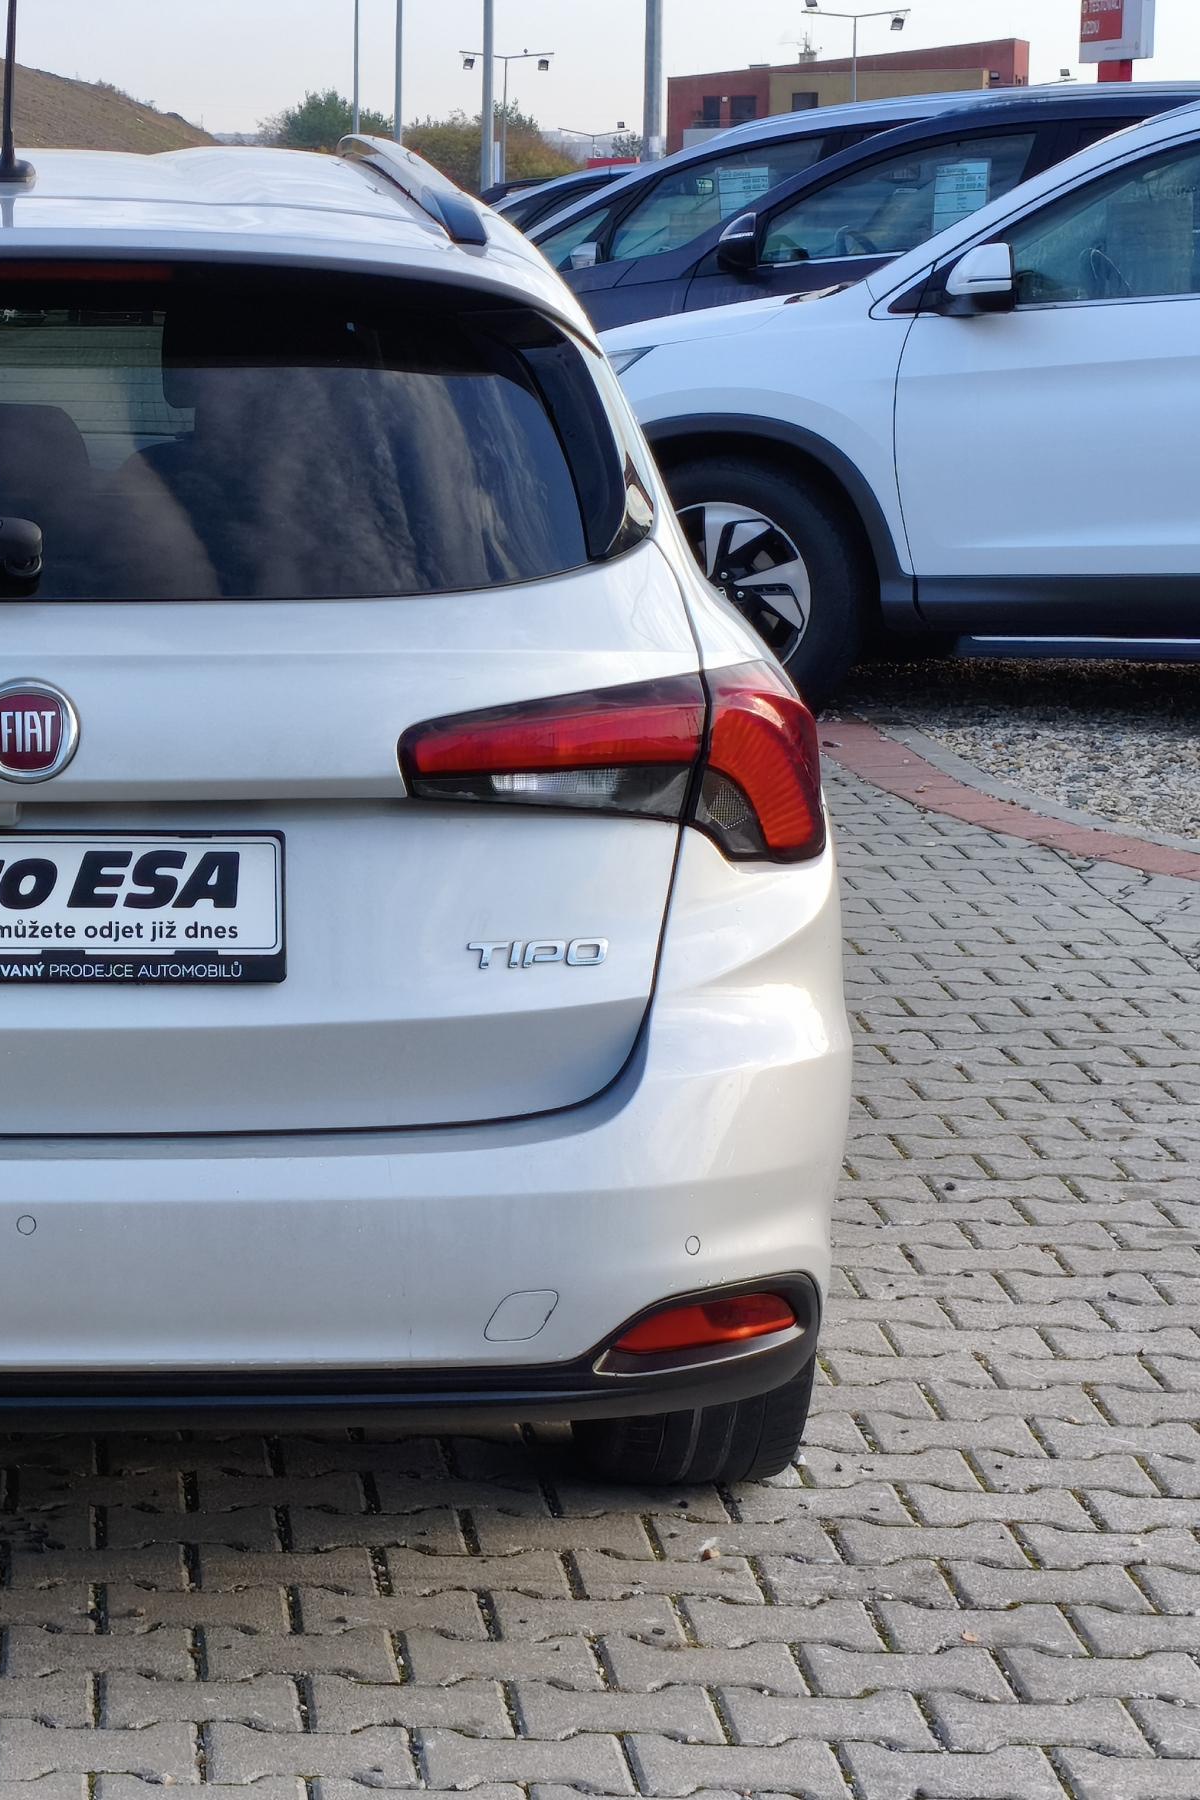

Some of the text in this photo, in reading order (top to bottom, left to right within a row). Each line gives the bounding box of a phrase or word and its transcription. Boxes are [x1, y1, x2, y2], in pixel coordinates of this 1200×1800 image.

[0, 711, 56, 752] FIAT
[67, 850, 240, 909] ESA
[84, 921, 144, 942] odjet
[150, 920, 176, 942] již
[184, 921, 238, 938] dnes
[50, 965, 133, 977] PRODEJCE
[137, 961, 242, 977] AUTOMOBILŮ
[467, 938, 609, 969] TIPO
